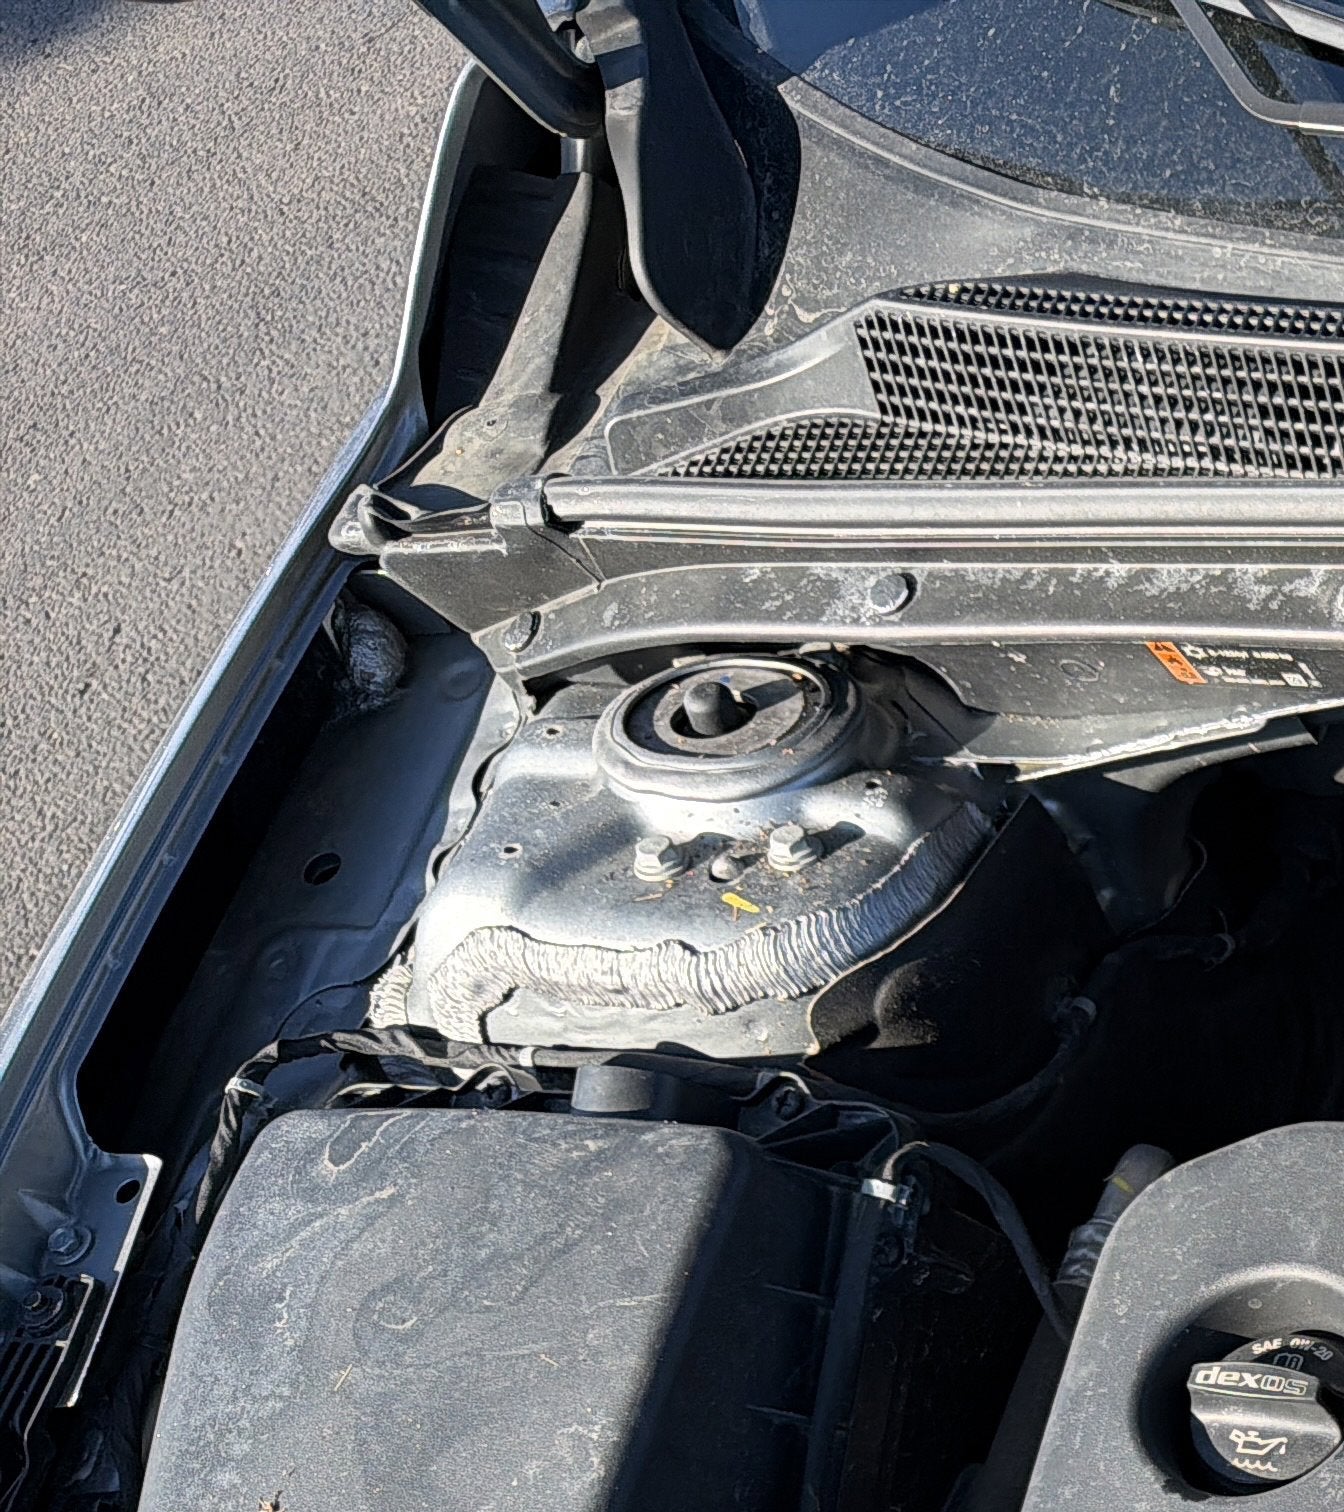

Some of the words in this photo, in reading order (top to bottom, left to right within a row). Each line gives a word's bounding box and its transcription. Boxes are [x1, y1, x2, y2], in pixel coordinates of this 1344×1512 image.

[1251, 1338, 1283, 1355] SAE
[1289, 1337, 1334, 1362] 0W-20
[1195, 1366, 1309, 1396] dexos
